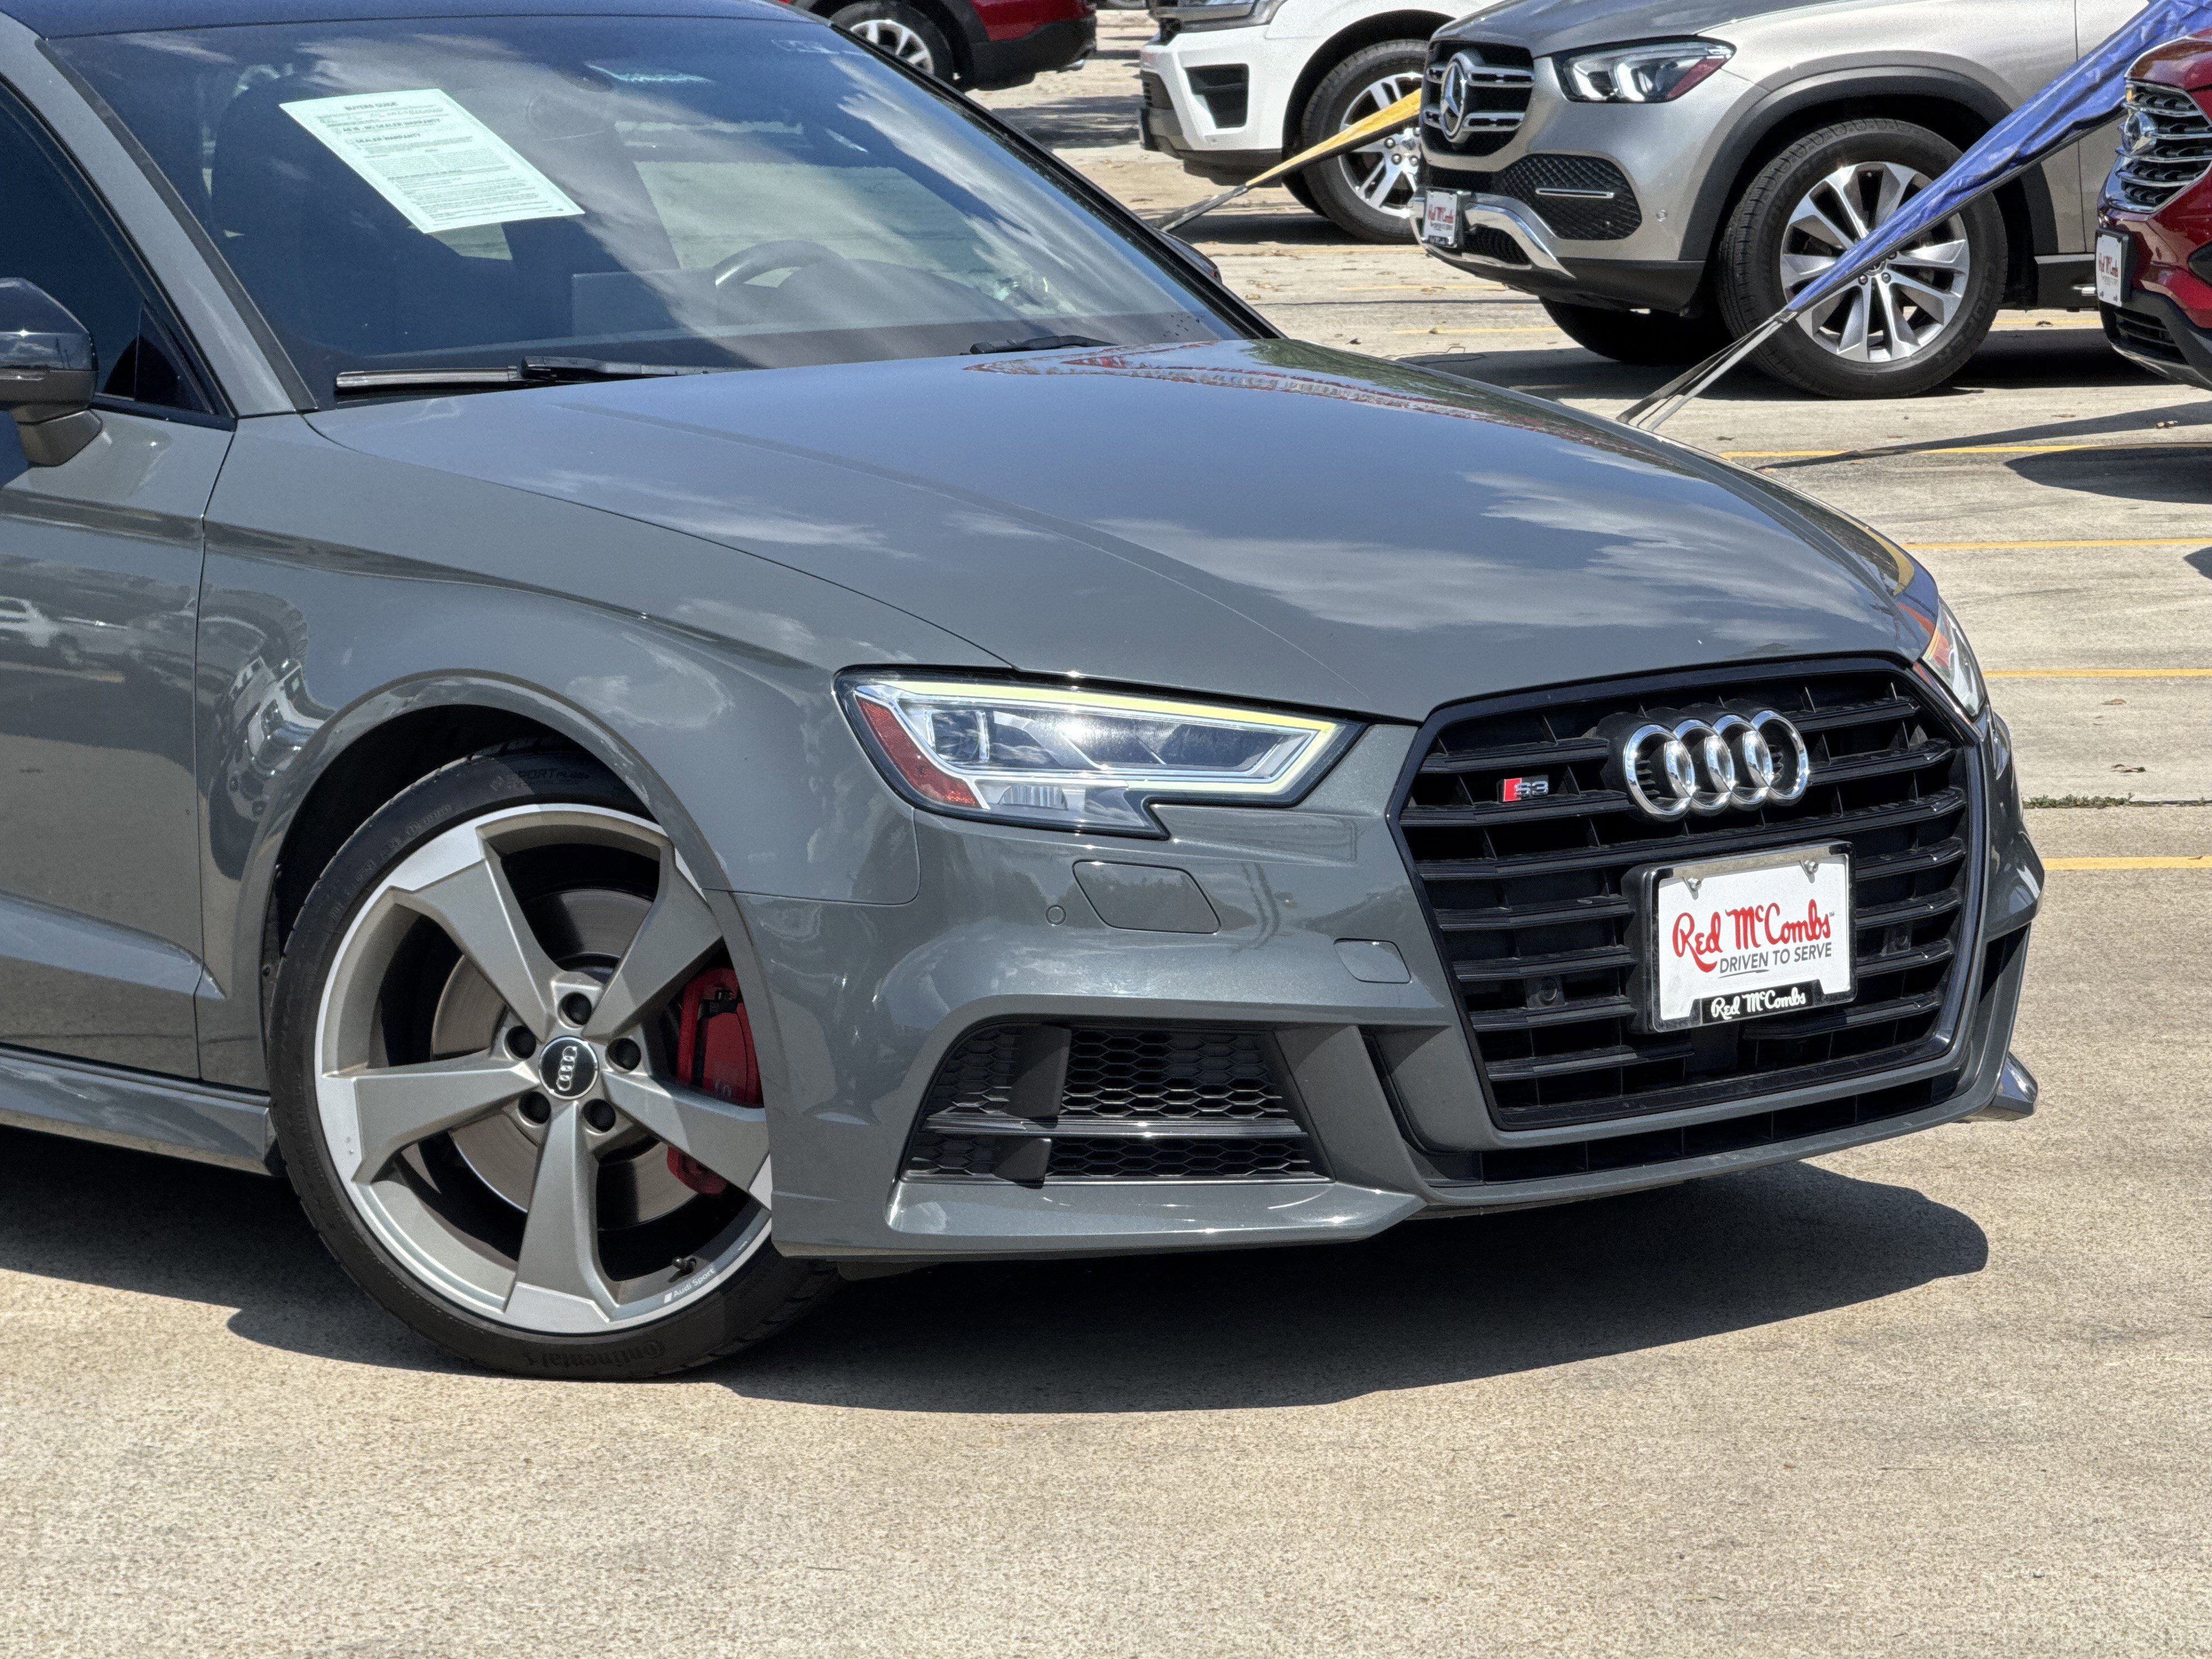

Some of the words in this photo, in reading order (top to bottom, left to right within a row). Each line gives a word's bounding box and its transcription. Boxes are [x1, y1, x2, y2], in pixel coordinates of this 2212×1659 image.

[1514, 781, 1548, 797] S3
[1672, 912, 1723, 973] Red
[1719, 951, 1769, 974] DRIVEN
[1773, 948, 1791, 966] TO
[1794, 942, 1832, 962] SERVE
[1711, 995, 1740, 1020] Red
[673, 1283, 692, 1297] Audi
[692, 1267, 715, 1286] Sport
